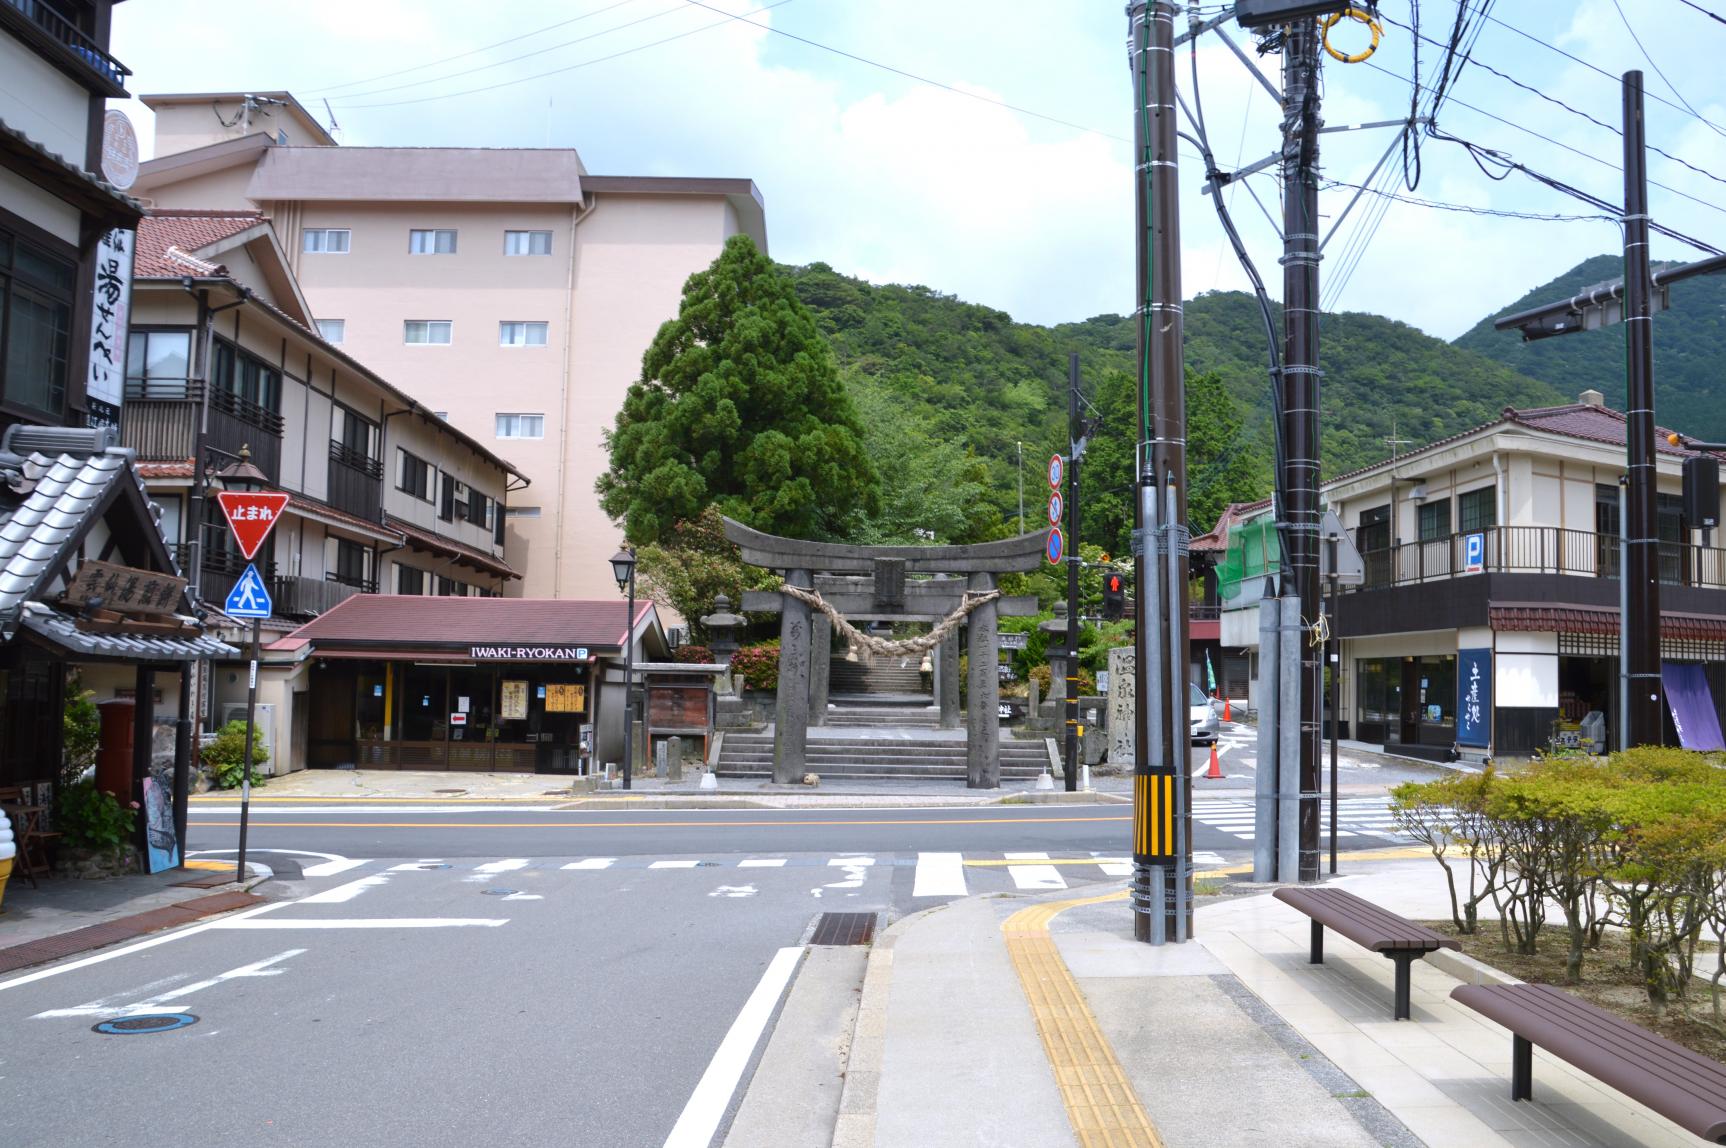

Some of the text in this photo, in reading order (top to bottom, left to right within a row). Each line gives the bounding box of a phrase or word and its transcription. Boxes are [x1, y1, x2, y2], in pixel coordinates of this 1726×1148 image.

[93, 258, 124, 383] 湯せんぺい
[231, 504, 274, 521] 止まれ
[1468, 536, 1481, 567] P
[471, 647, 587, 659] IWAKI-RYOKAN P
